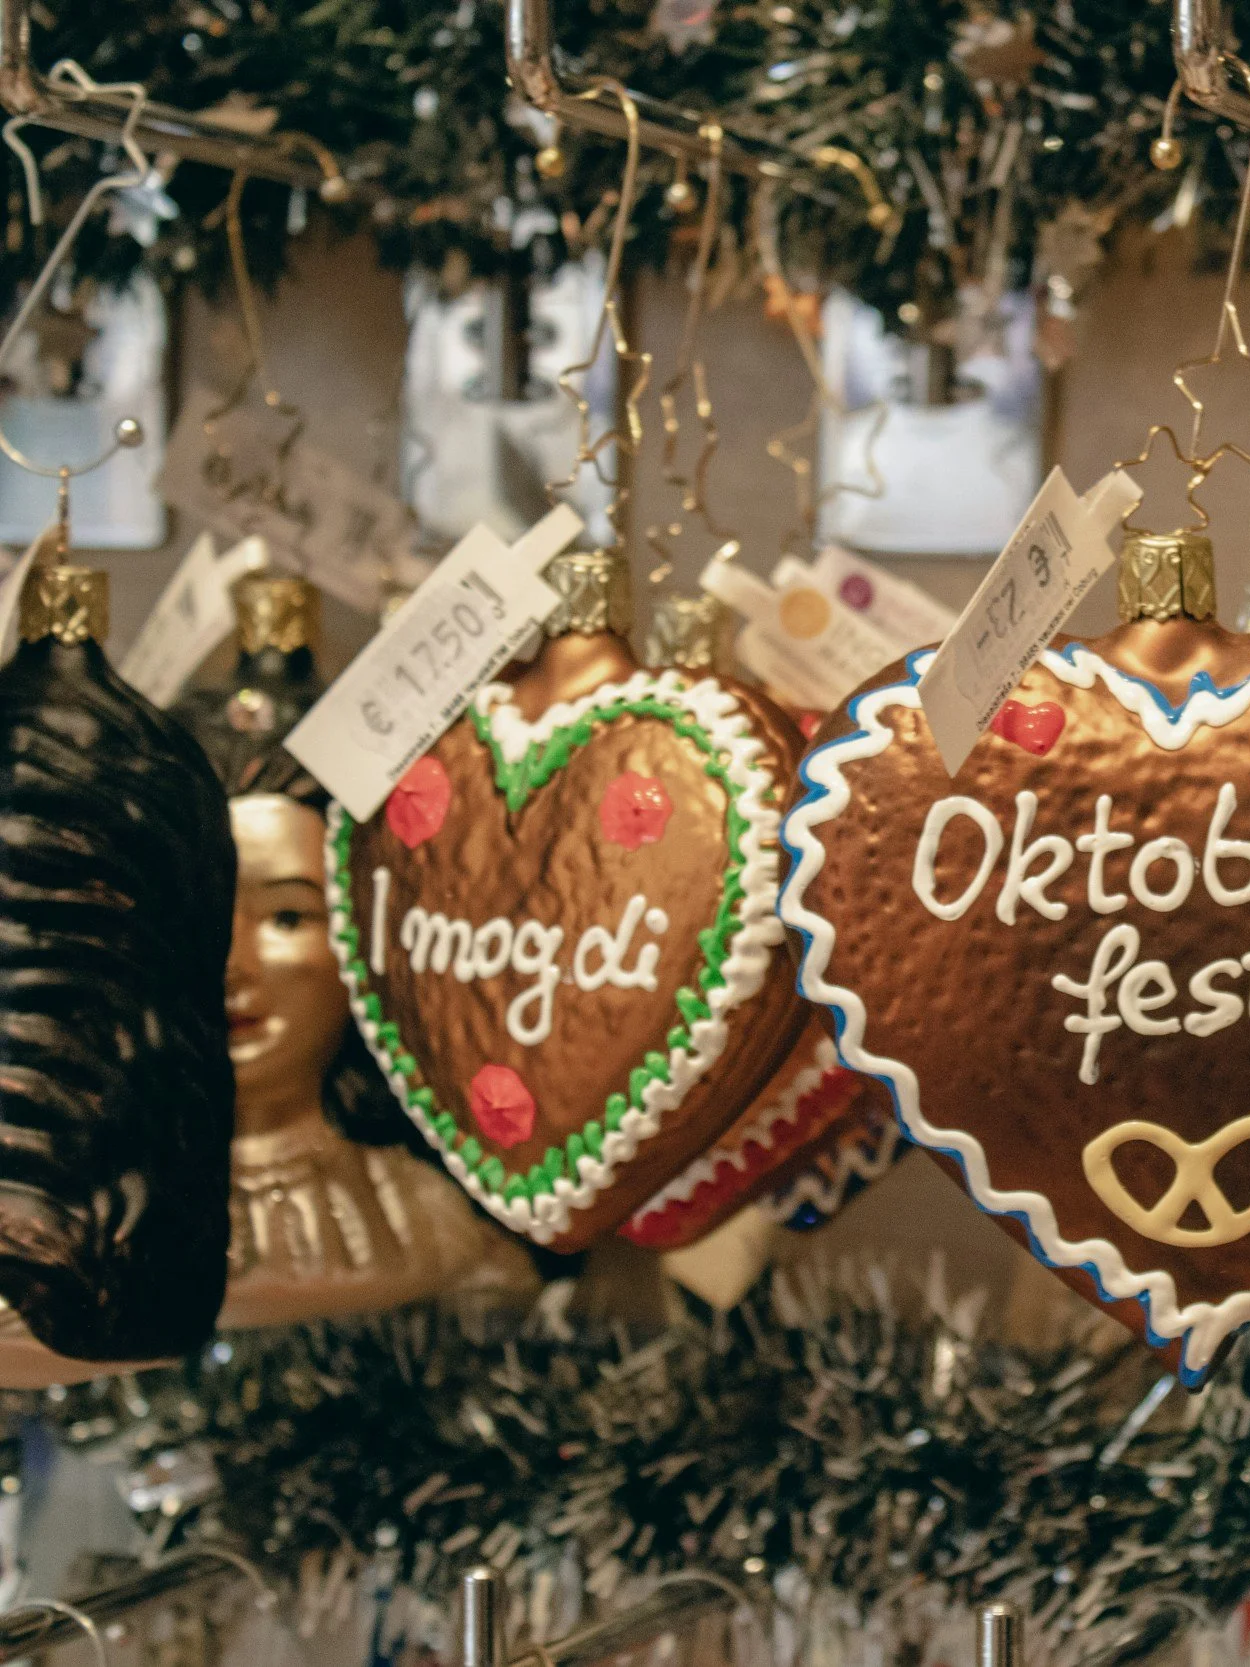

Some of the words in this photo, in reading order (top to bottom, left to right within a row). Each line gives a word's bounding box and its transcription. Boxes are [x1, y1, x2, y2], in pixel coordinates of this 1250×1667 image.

[360, 700, 395, 737] €
[369, 865, 392, 976] I
[400, 906, 565, 1047] mog
[573, 893, 670, 993] di
